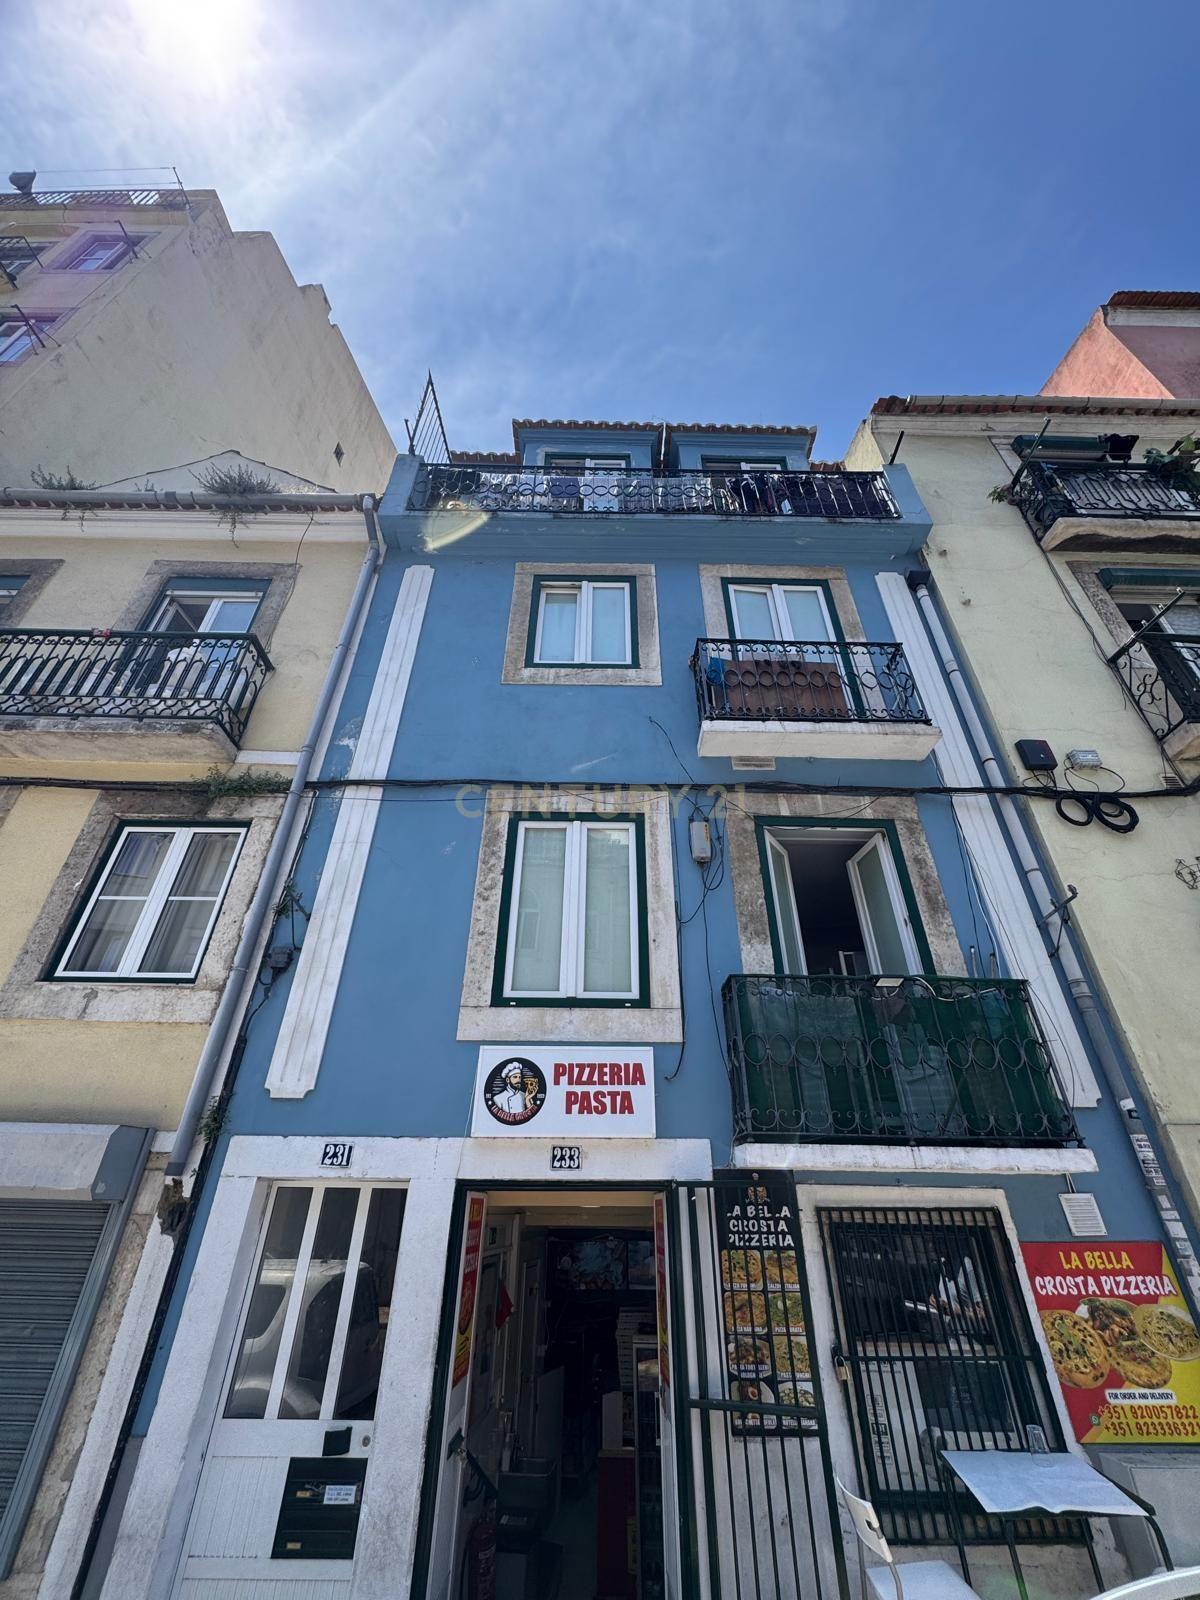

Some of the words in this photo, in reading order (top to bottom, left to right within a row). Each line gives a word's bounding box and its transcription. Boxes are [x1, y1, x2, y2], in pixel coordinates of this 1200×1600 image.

[553, 1062, 646, 1086] PIZZERIA
[565, 1090, 634, 1115] PASTA
[322, 1144, 350, 1166] 231
[552, 1147, 580, 1168] 233
[1059, 1251, 1083, 1269] LA
[1084, 1251, 1134, 1270] BELLA
[1034, 1275, 1100, 1296] CROSTA
[1101, 1275, 1178, 1297] PIZZERIA
[1108, 1392, 1119, 1400] FOR
[1120, 1392, 1138, 1400] ORDER
[1138, 1392, 1149, 1400] AND
[1150, 1392, 1174, 1400] DELIVERY
[1098, 1404, 1128, 1419] +351
[1130, 1404, 1198, 1419] 920057822
[1104, 1421, 1133, 1437] +351
[1135, 1421, 1200, 1436] 92333632
